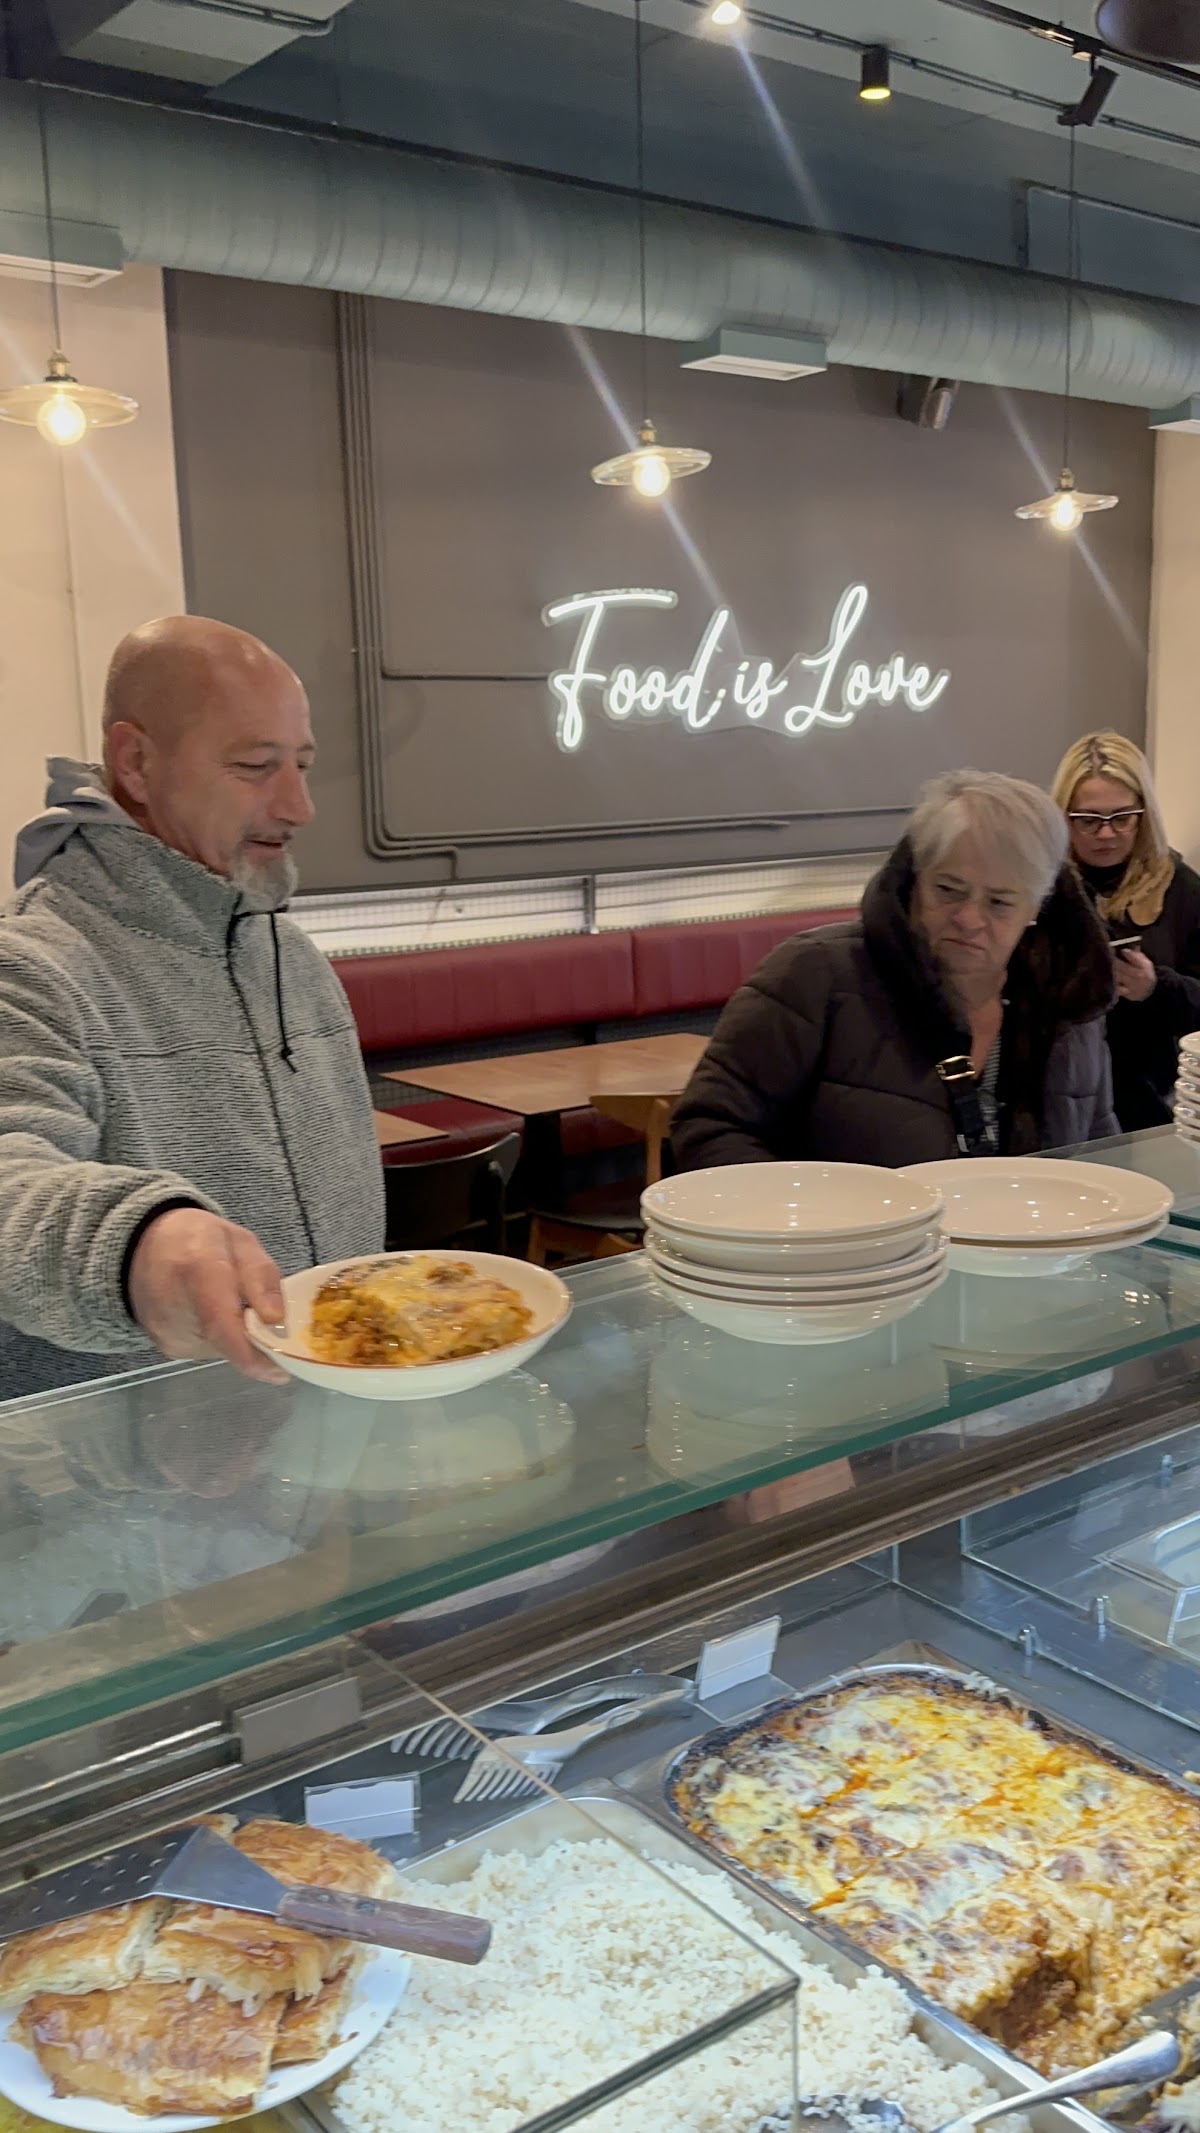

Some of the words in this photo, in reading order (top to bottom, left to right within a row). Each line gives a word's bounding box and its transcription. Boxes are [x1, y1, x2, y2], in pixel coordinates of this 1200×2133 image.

[545, 589, 730, 749] Food
[734, 660, 788, 719] is
[784, 583, 950, 734] Love
